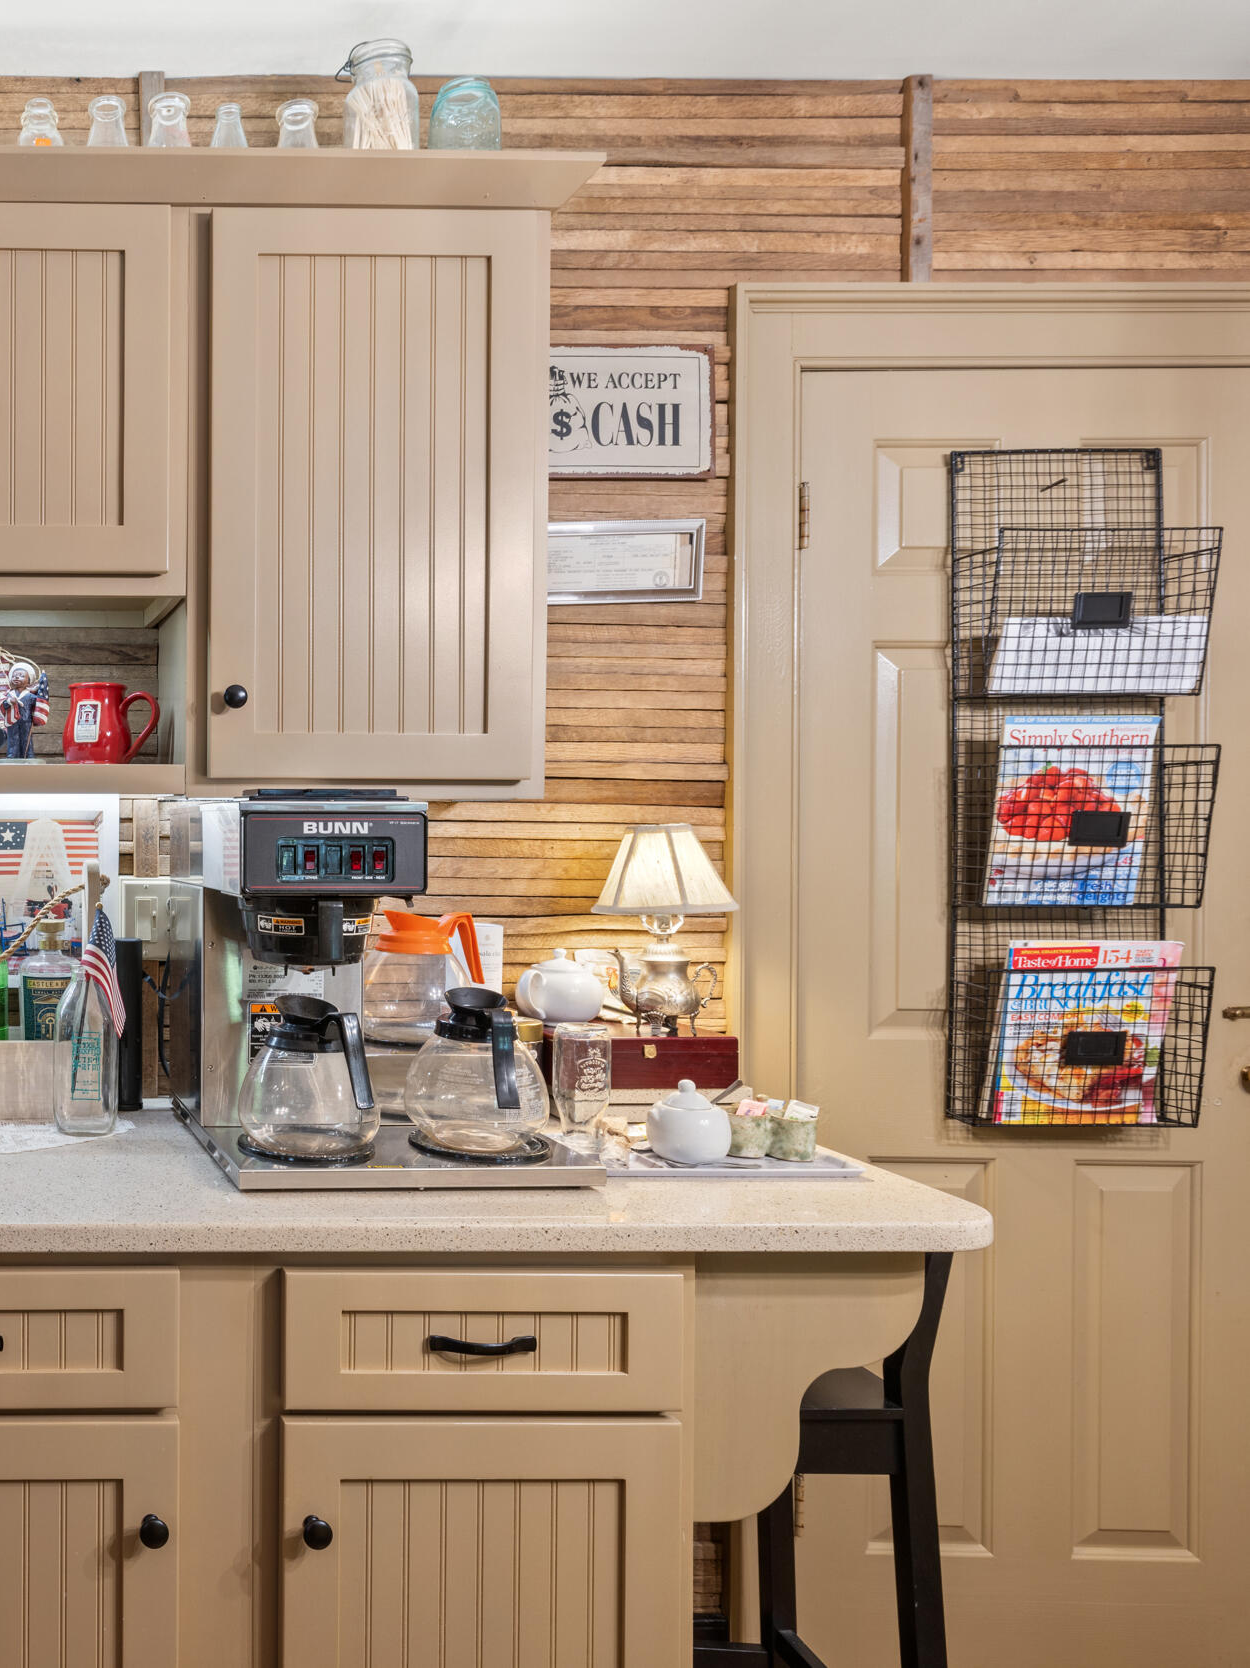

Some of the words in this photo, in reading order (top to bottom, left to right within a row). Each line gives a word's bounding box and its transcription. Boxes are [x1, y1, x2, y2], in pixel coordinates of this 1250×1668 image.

[570, 372, 599, 389] WE
[605, 371, 681, 390] ACCEPT
[591, 401, 682, 447] CASH
[1009, 728, 1068, 751] Simply
[1070, 728, 1149, 746] Southern
[303, 821, 369, 834] BUNN
[1014, 956, 1050, 968] Taste
[1056, 955, 1097, 967] Home
[1102, 949, 1133, 964] 154
[1015, 971, 1151, 1004] Breakfast
[1011, 1013, 1035, 1022] EASY
